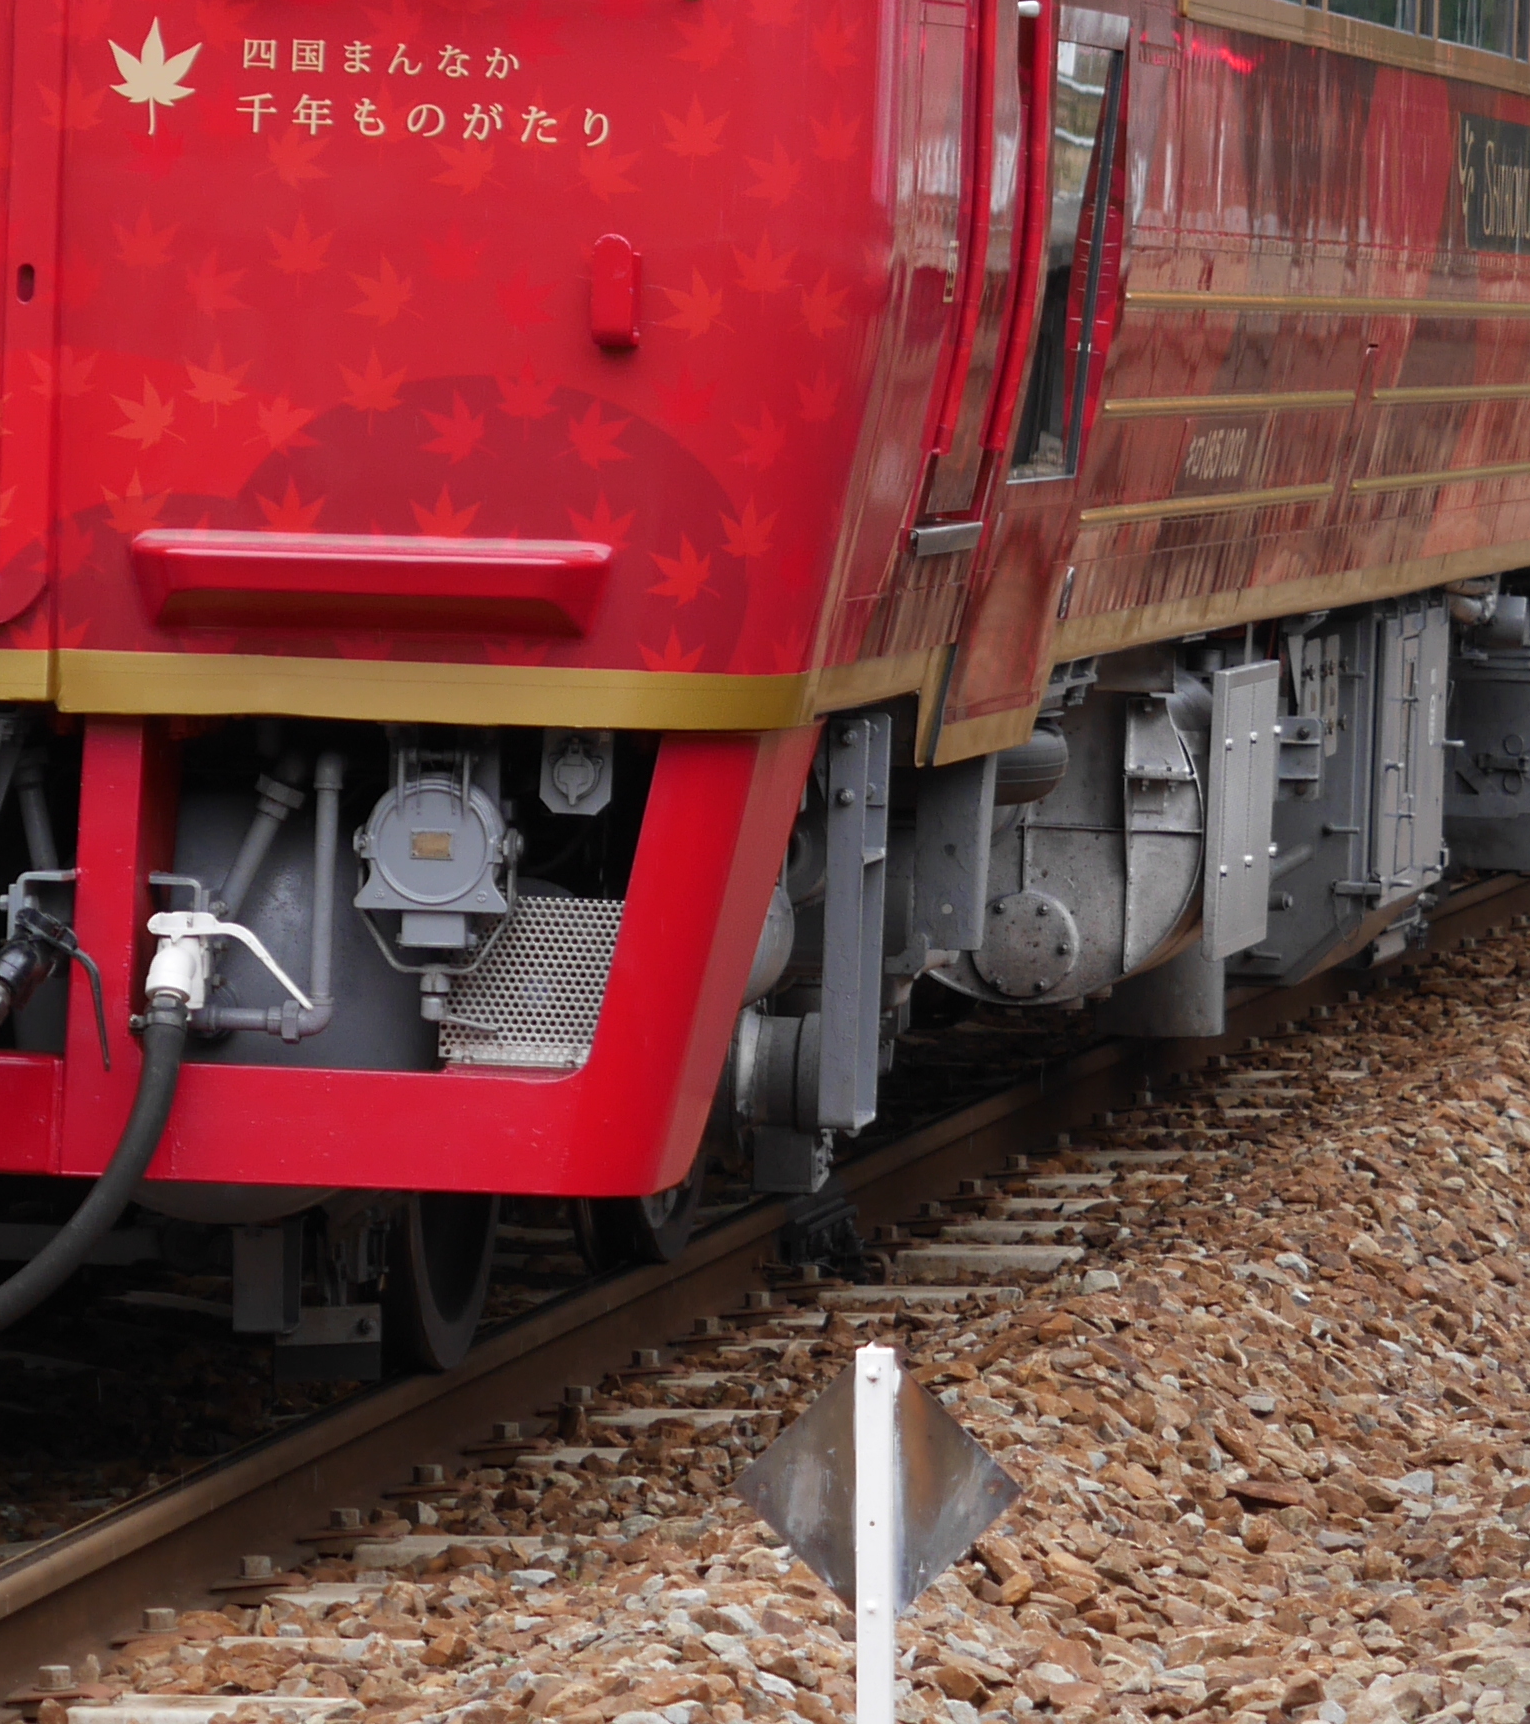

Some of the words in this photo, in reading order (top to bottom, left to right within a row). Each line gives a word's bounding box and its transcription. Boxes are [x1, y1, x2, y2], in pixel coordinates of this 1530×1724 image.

[242, 37, 520, 79] 四国まんなか
[235, 91, 611, 148] 千年ものがたり
